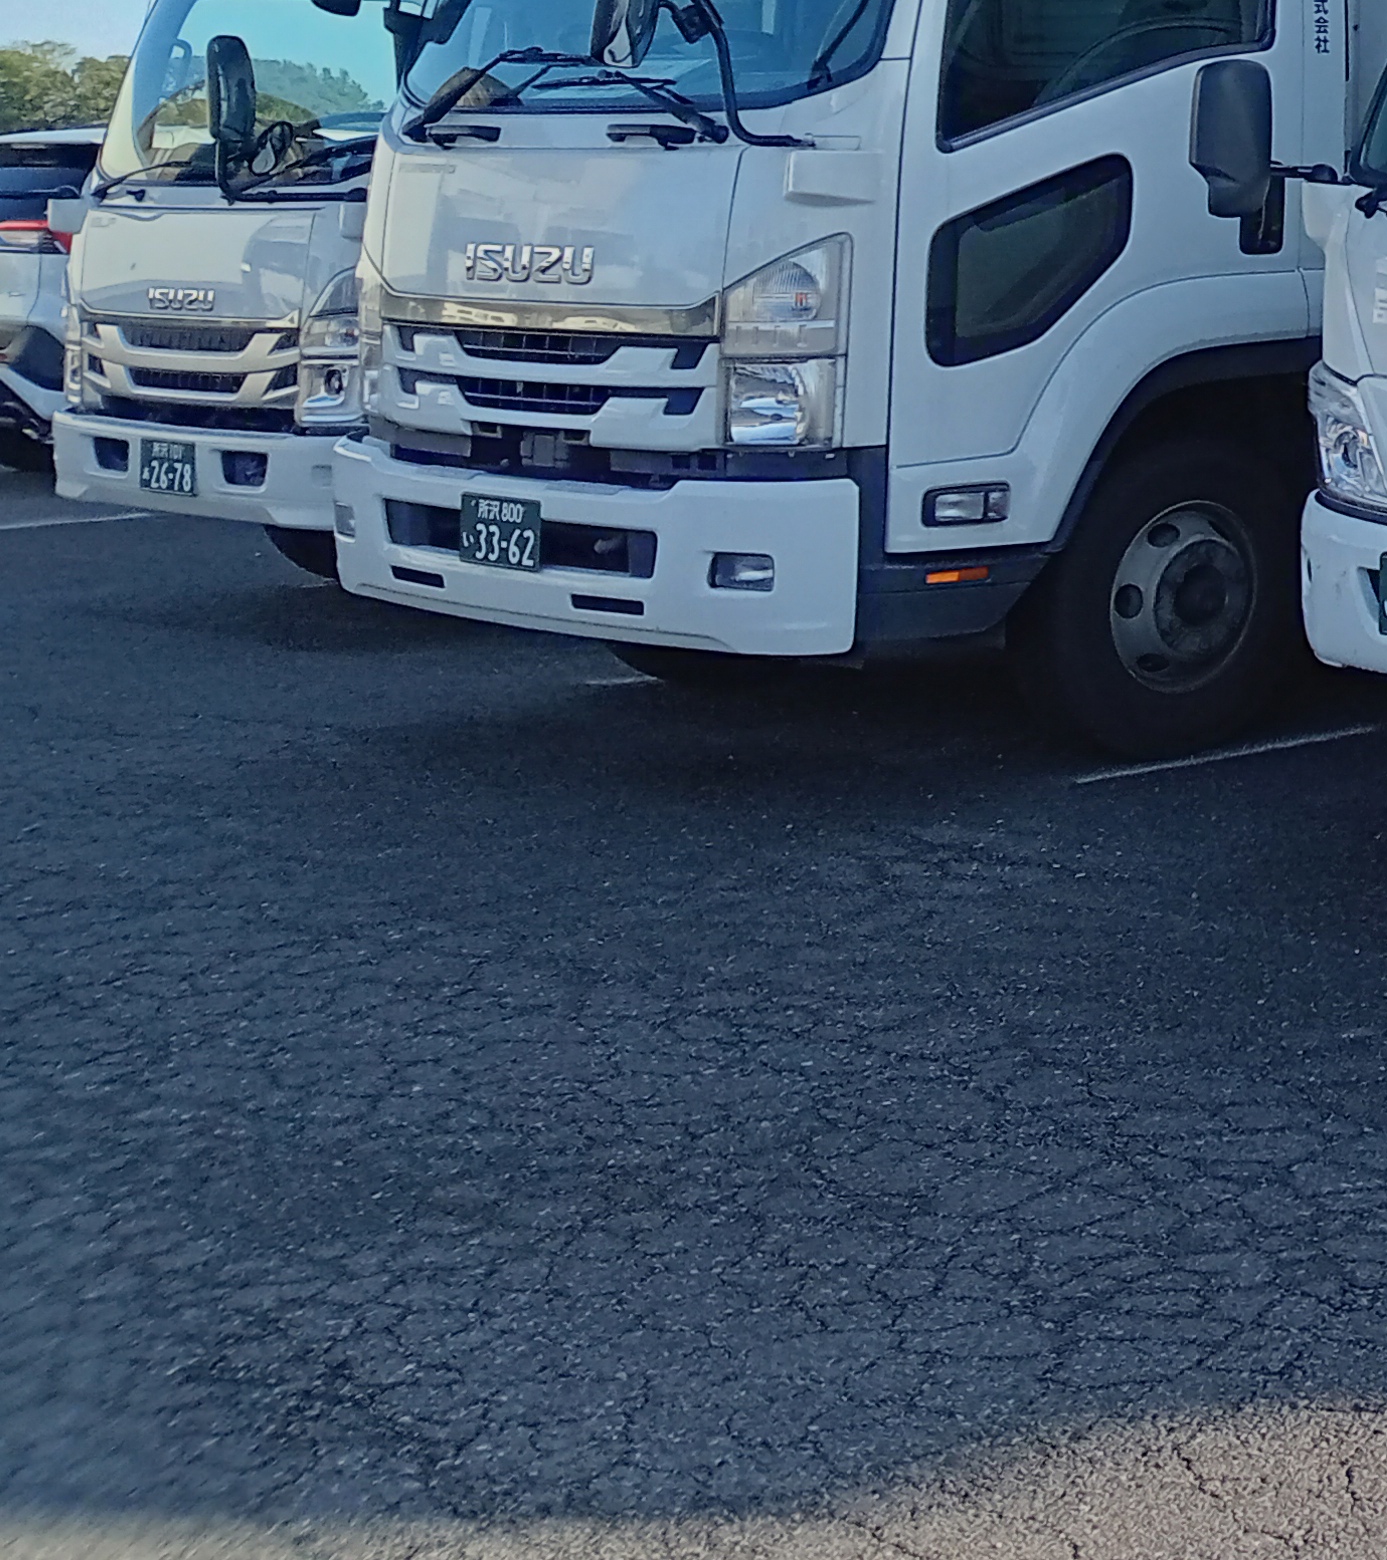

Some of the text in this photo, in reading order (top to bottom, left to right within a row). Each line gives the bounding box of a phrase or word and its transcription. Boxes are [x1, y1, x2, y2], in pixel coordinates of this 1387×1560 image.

[464, 241, 596, 286] ISUZU
[147, 286, 216, 312] ISUZU
[150, 460, 192, 492] 26-78
[477, 498, 523, 524] 所沢 800
[462, 522, 535, 567] い 33-62
